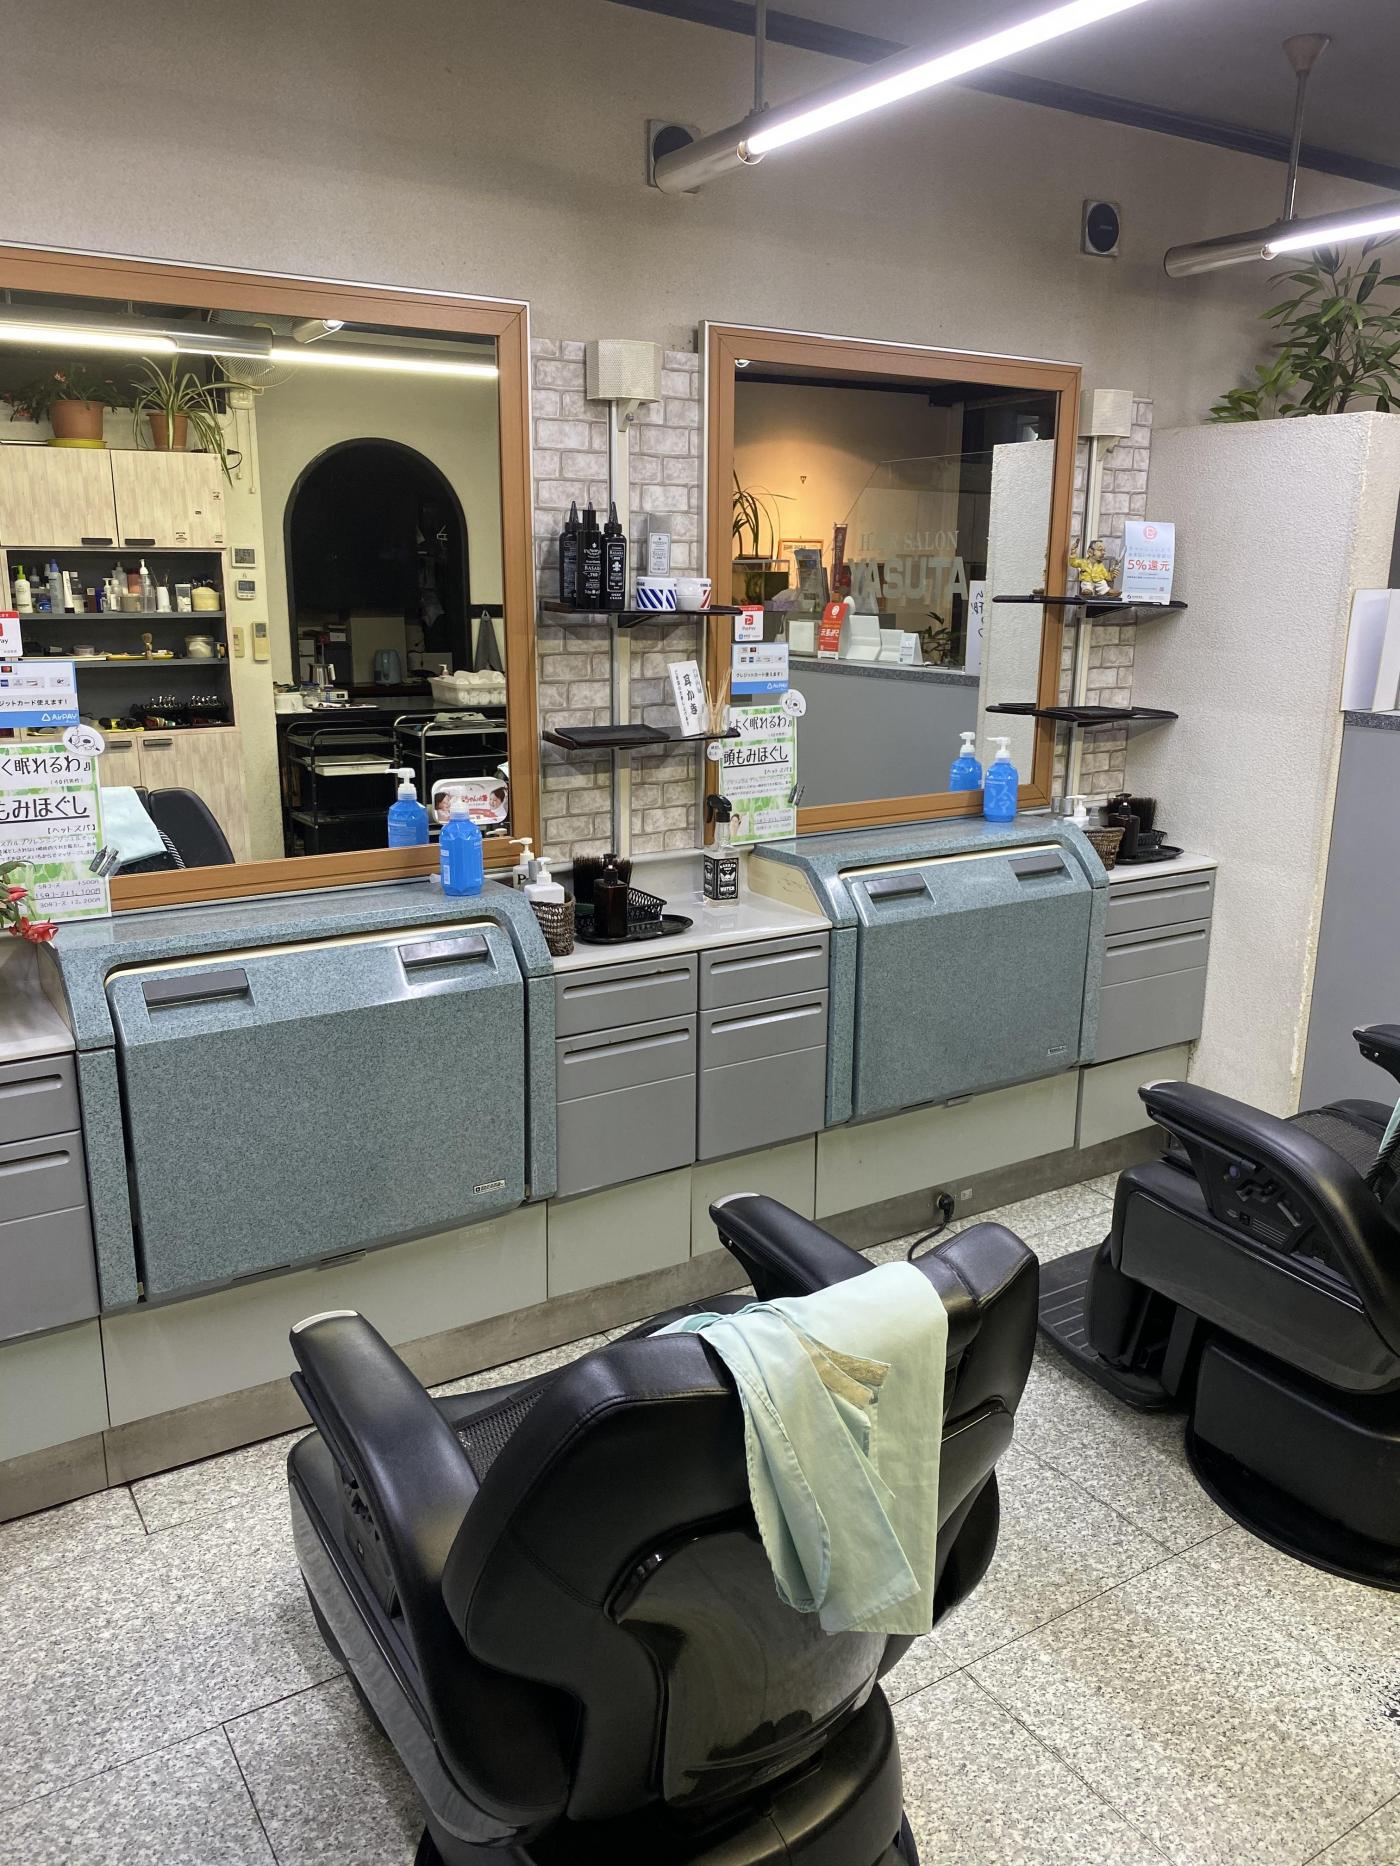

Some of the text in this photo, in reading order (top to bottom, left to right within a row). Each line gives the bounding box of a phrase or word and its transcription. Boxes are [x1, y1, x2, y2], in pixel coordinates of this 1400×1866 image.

[903, 529, 960, 551] SALON
[1127, 559, 1170, 572] 5%還元
[848, 555, 969, 601] YASUTA
[723, 745, 788, 765] 頭もみほぐし
